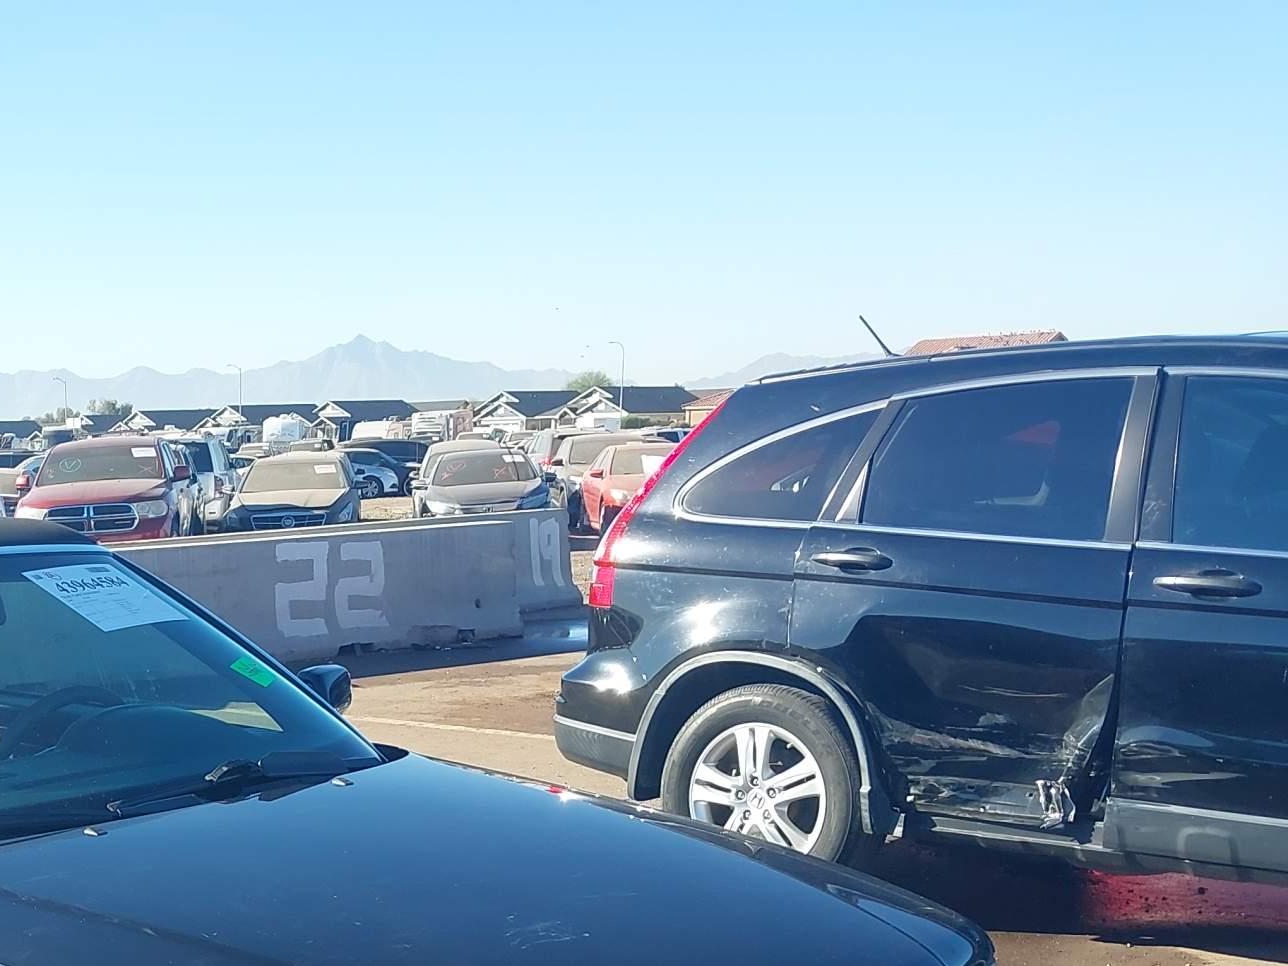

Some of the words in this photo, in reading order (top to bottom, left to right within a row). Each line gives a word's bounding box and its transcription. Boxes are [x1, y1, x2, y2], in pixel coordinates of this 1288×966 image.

[55, 575, 130, 594] 43964584
[529, 516, 567, 587] 19
[274, 540, 390, 637] 22
